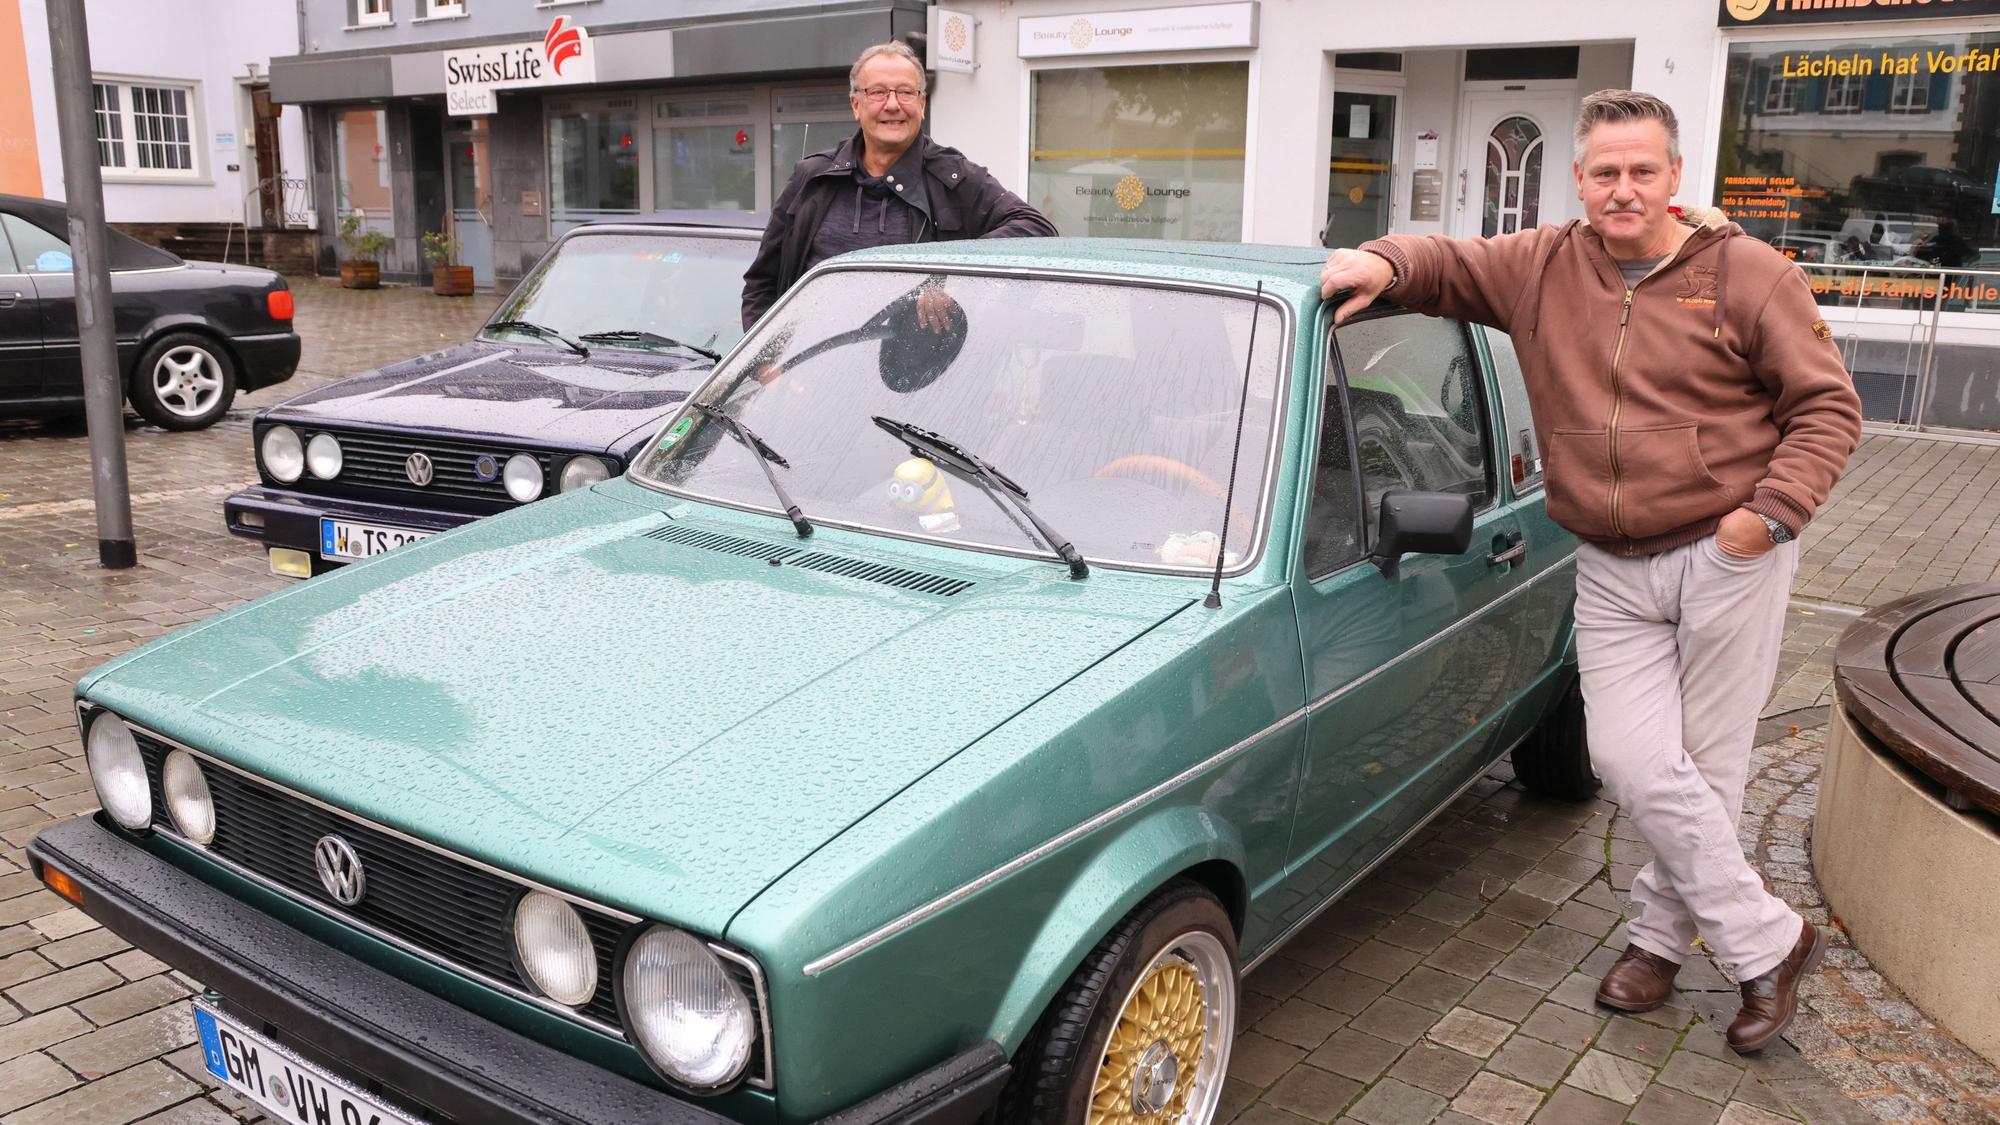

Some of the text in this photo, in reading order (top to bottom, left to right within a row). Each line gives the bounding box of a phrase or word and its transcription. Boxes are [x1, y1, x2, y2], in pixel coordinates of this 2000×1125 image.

[1094, 27, 1133, 37] Lounge
[448, 48, 541, 85] SwissLife
[1783, 52, 1873, 77] Lächeln
[1880, 51, 1919, 75] hat
[450, 91, 487, 111] Select
[1075, 186, 1190, 198] Beauty Lounge
[1745, 198, 1786, 208] Anmeldung
[220, 1029, 266, 1098] GM
